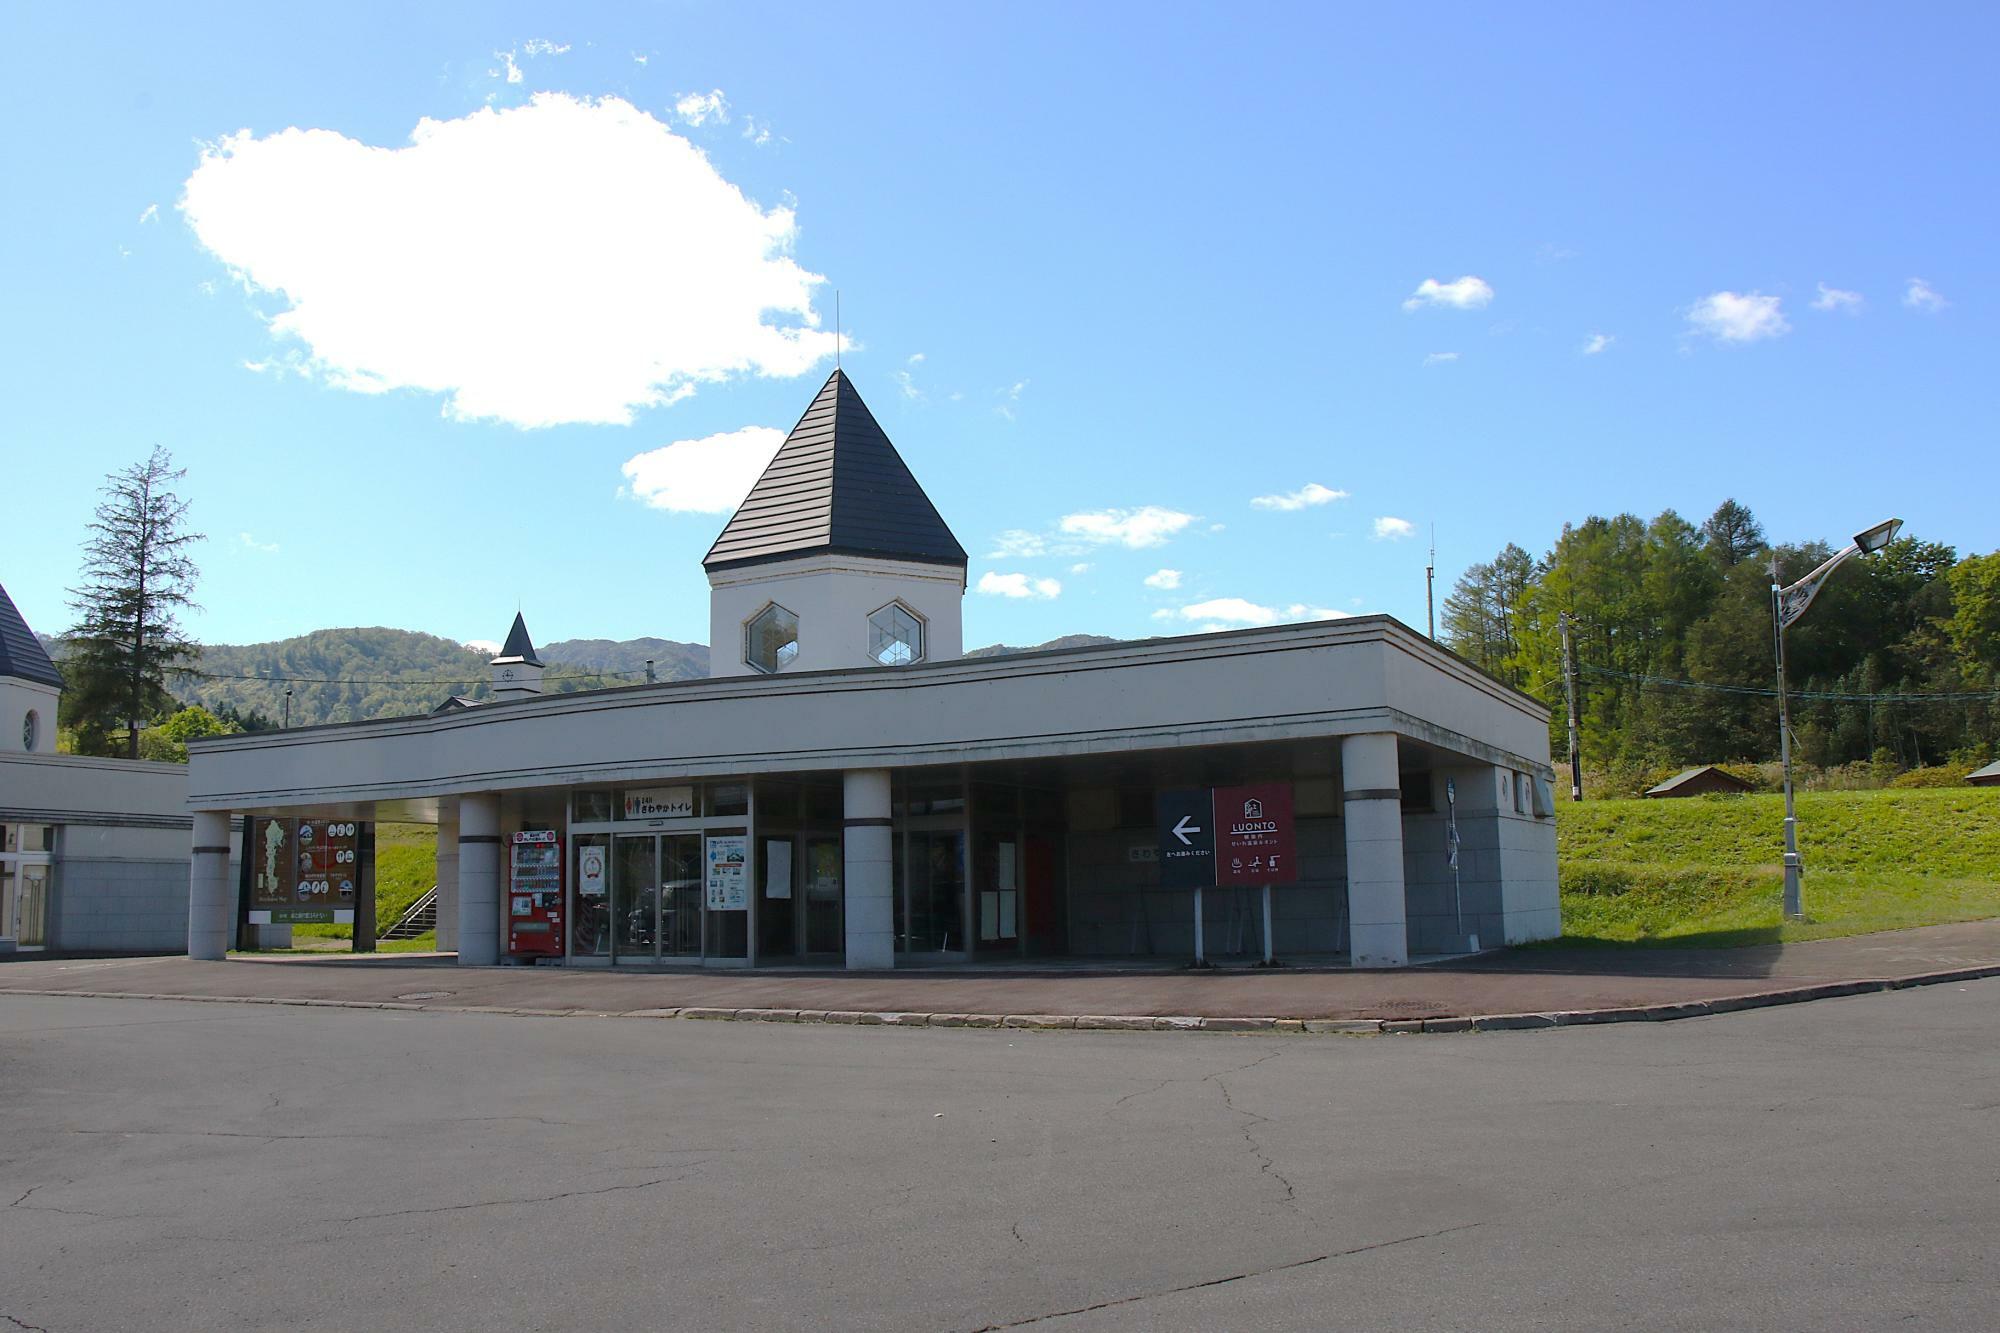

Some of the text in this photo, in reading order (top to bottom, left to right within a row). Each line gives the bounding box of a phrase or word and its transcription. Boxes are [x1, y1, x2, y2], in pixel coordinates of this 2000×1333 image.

[641, 803, 692, 814] さわやかトイレ
[1232, 821, 1276, 832] LUONTO
